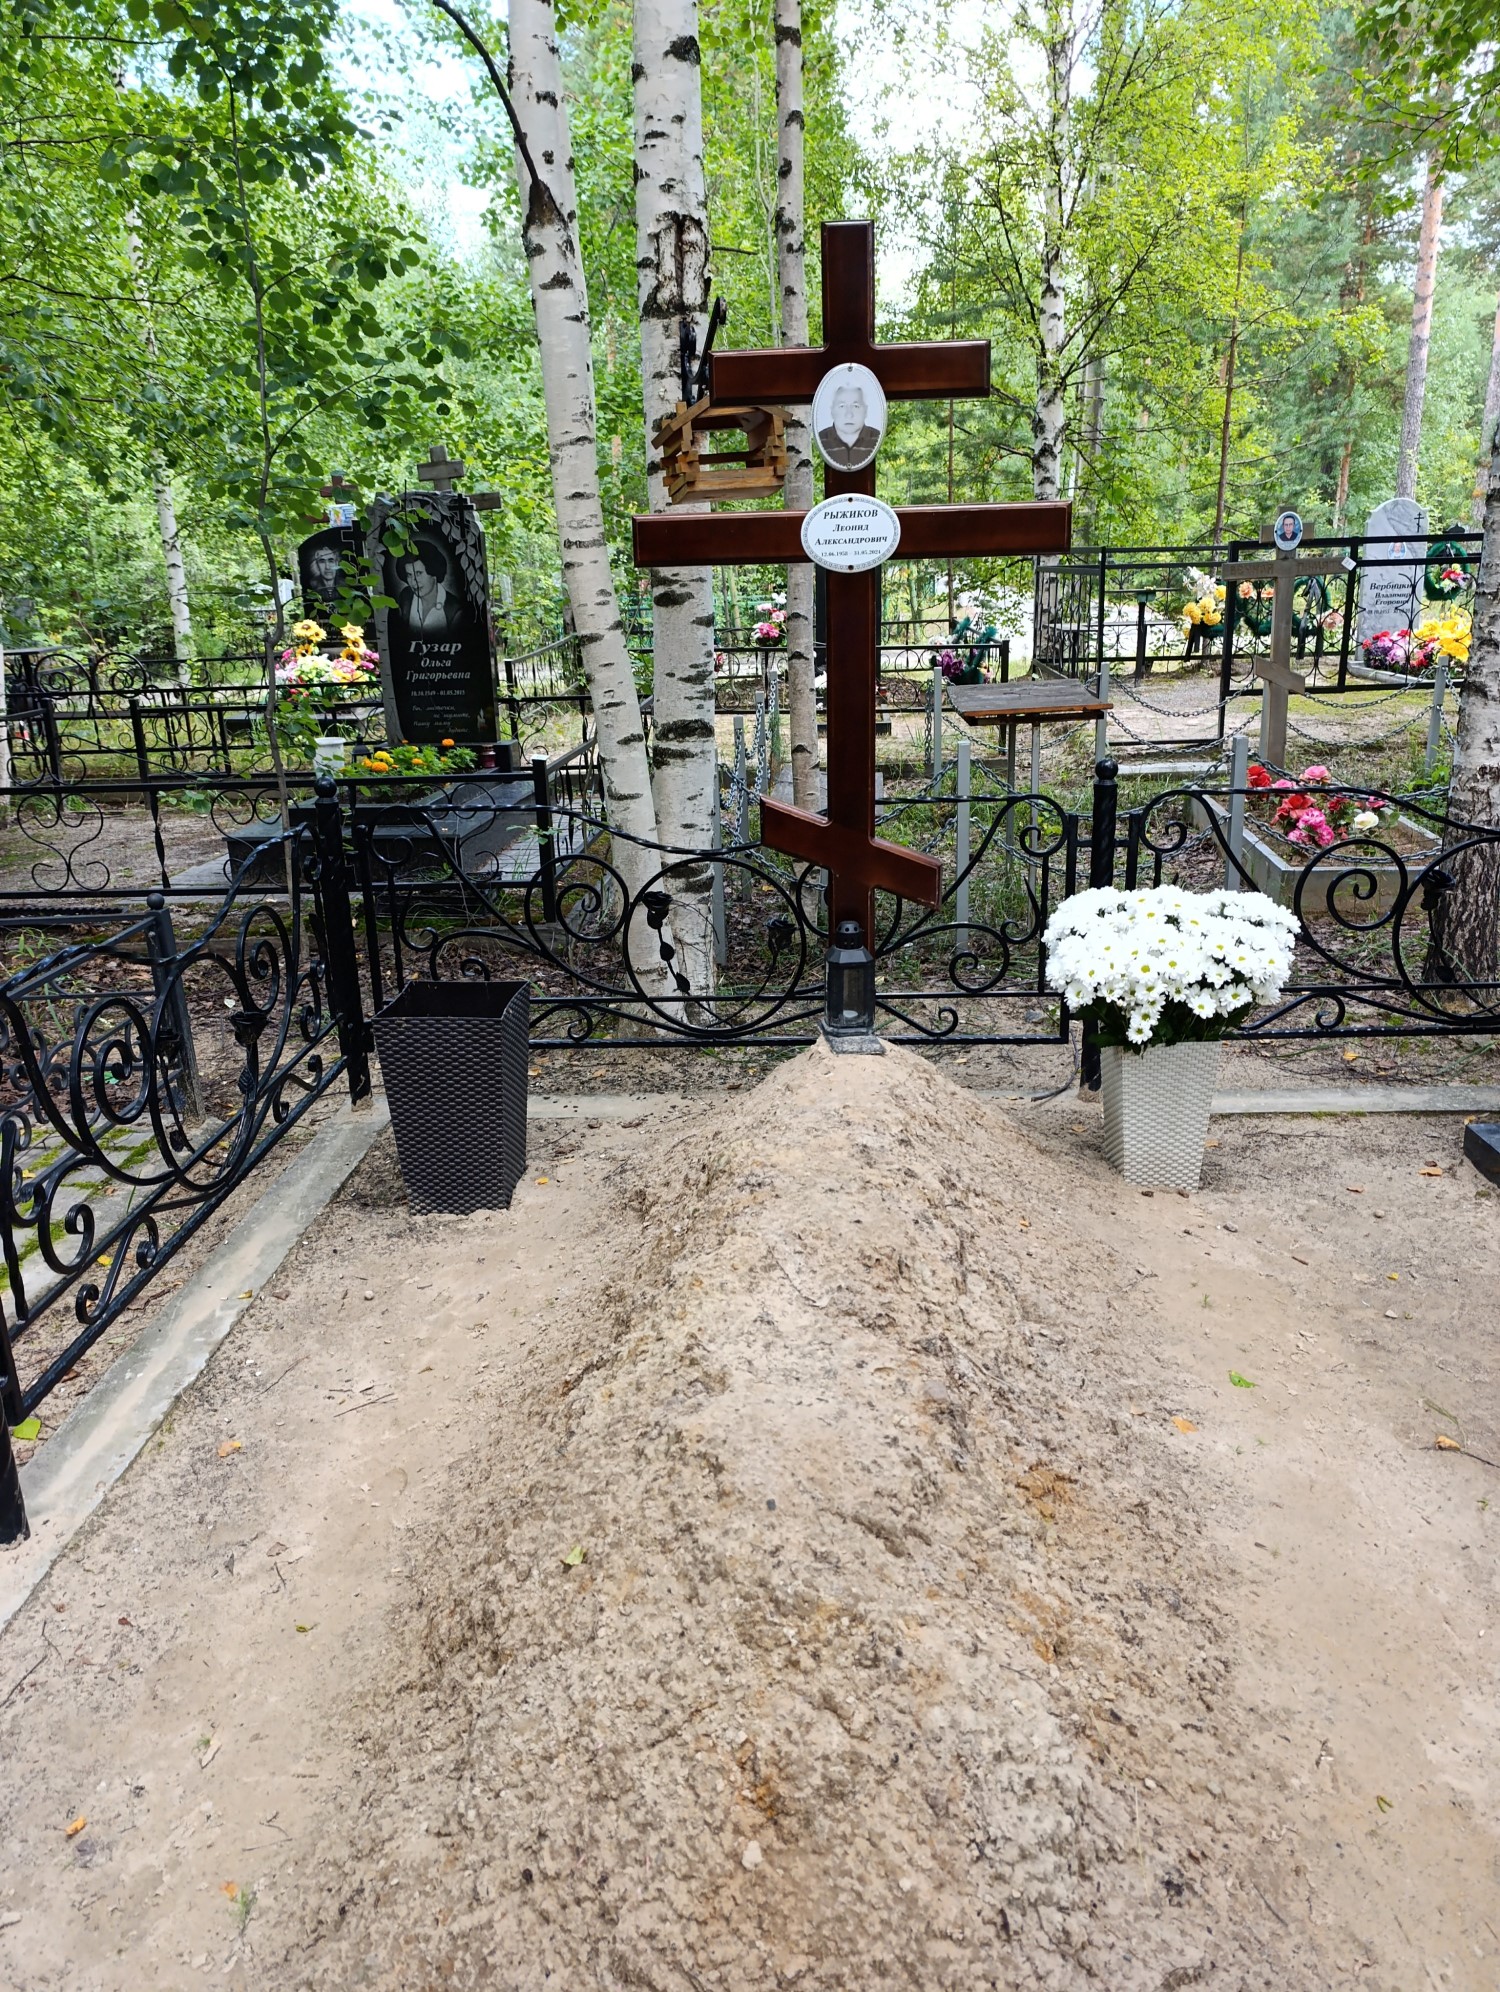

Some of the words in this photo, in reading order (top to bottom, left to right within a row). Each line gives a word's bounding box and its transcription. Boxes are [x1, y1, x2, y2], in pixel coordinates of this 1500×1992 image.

[823, 509, 878, 520] РЫЖИКОВ
[408, 640, 462, 655] Гузар
[420, 657, 452, 668] Ольга
[406, 670, 471, 682] Григорьевна
